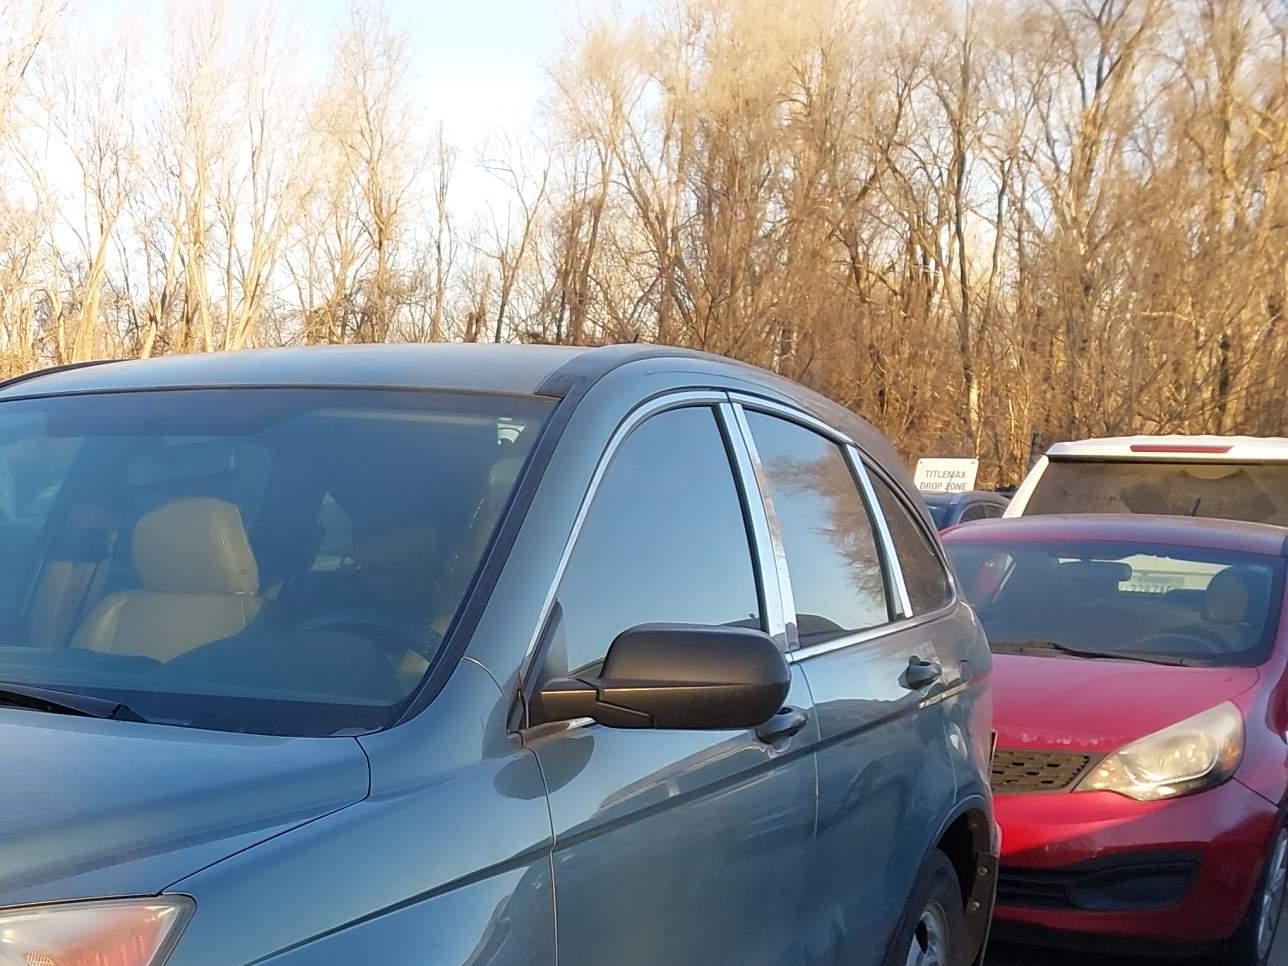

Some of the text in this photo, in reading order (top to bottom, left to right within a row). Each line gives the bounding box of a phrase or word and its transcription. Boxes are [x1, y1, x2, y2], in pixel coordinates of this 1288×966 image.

[925, 470, 967, 479] TITLEMAX
[919, 481, 968, 491] DROP ZONE
